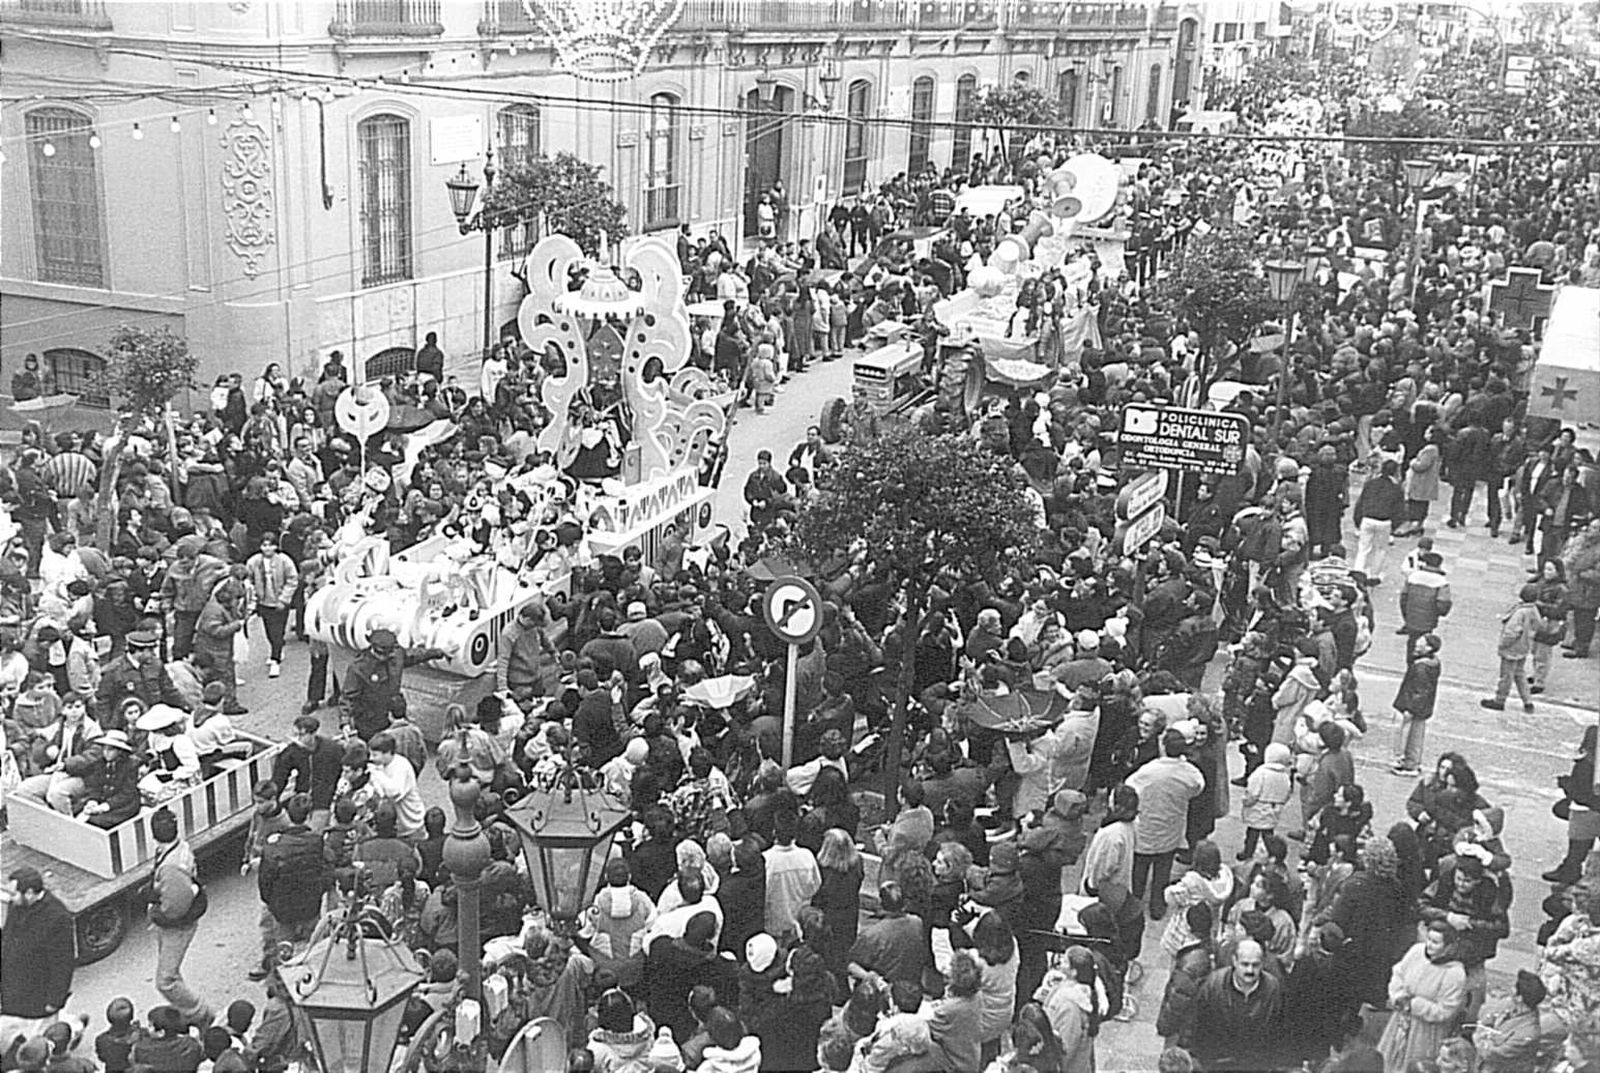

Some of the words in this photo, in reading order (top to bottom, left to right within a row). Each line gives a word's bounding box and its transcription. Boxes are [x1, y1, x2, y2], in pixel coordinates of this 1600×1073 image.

[1161, 412, 1239, 429] POLICLINICA
[1160, 422, 1208, 440] DENTAL
[1214, 429, 1240, 444] SUR
[1182, 440, 1221, 452] GENERAL
